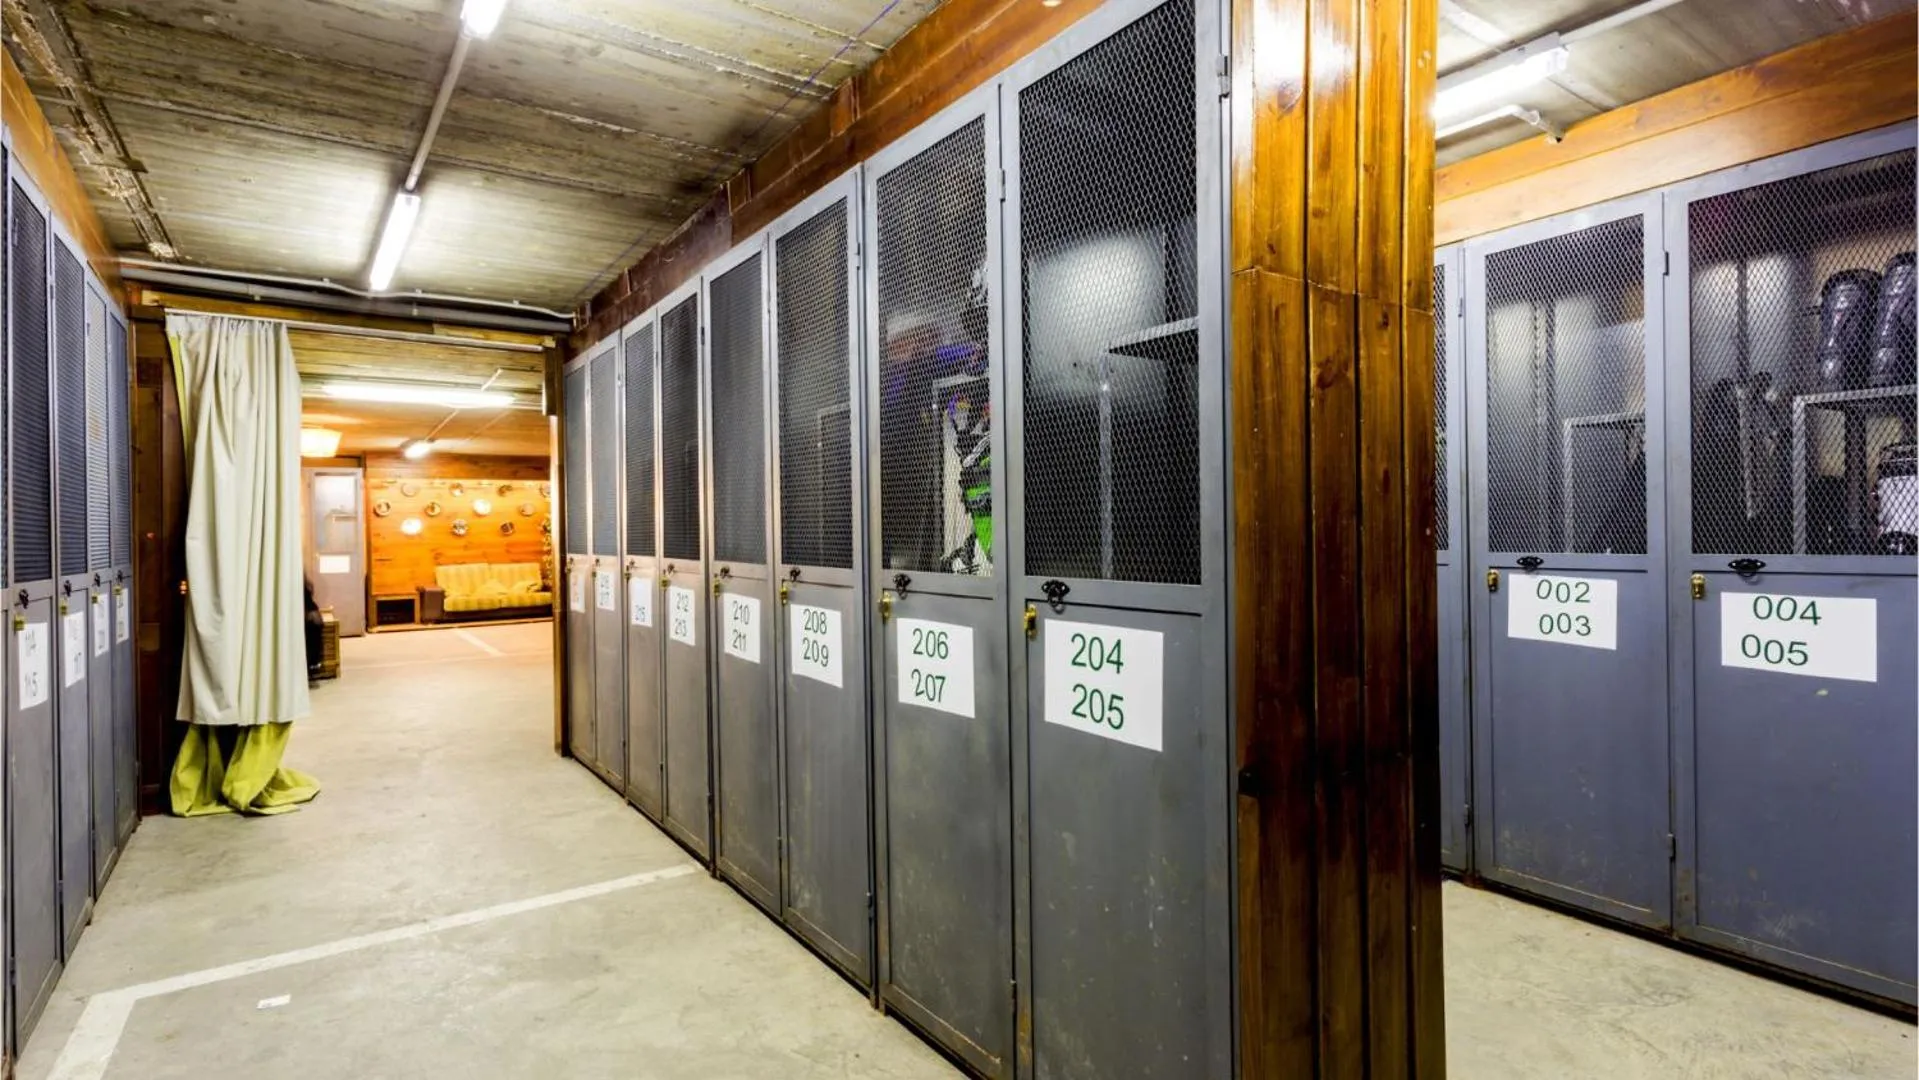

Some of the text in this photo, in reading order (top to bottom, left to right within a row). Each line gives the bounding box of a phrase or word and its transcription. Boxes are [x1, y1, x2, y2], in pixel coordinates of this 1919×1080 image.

[1536, 579, 1591, 604] 002
[732, 600, 751, 625] 210
[802, 608, 828, 635] 208
[1538, 612, 1592, 637] 003
[1752, 594, 1822, 626] 004
[731, 629, 748, 652] 211
[801, 637, 830, 668] 209
[912, 627, 949, 660] 206
[1070, 633, 1124, 674] 204
[1740, 633, 1809, 667] 005
[911, 668, 946, 704] 207
[1071, 683, 1124, 731] 205
